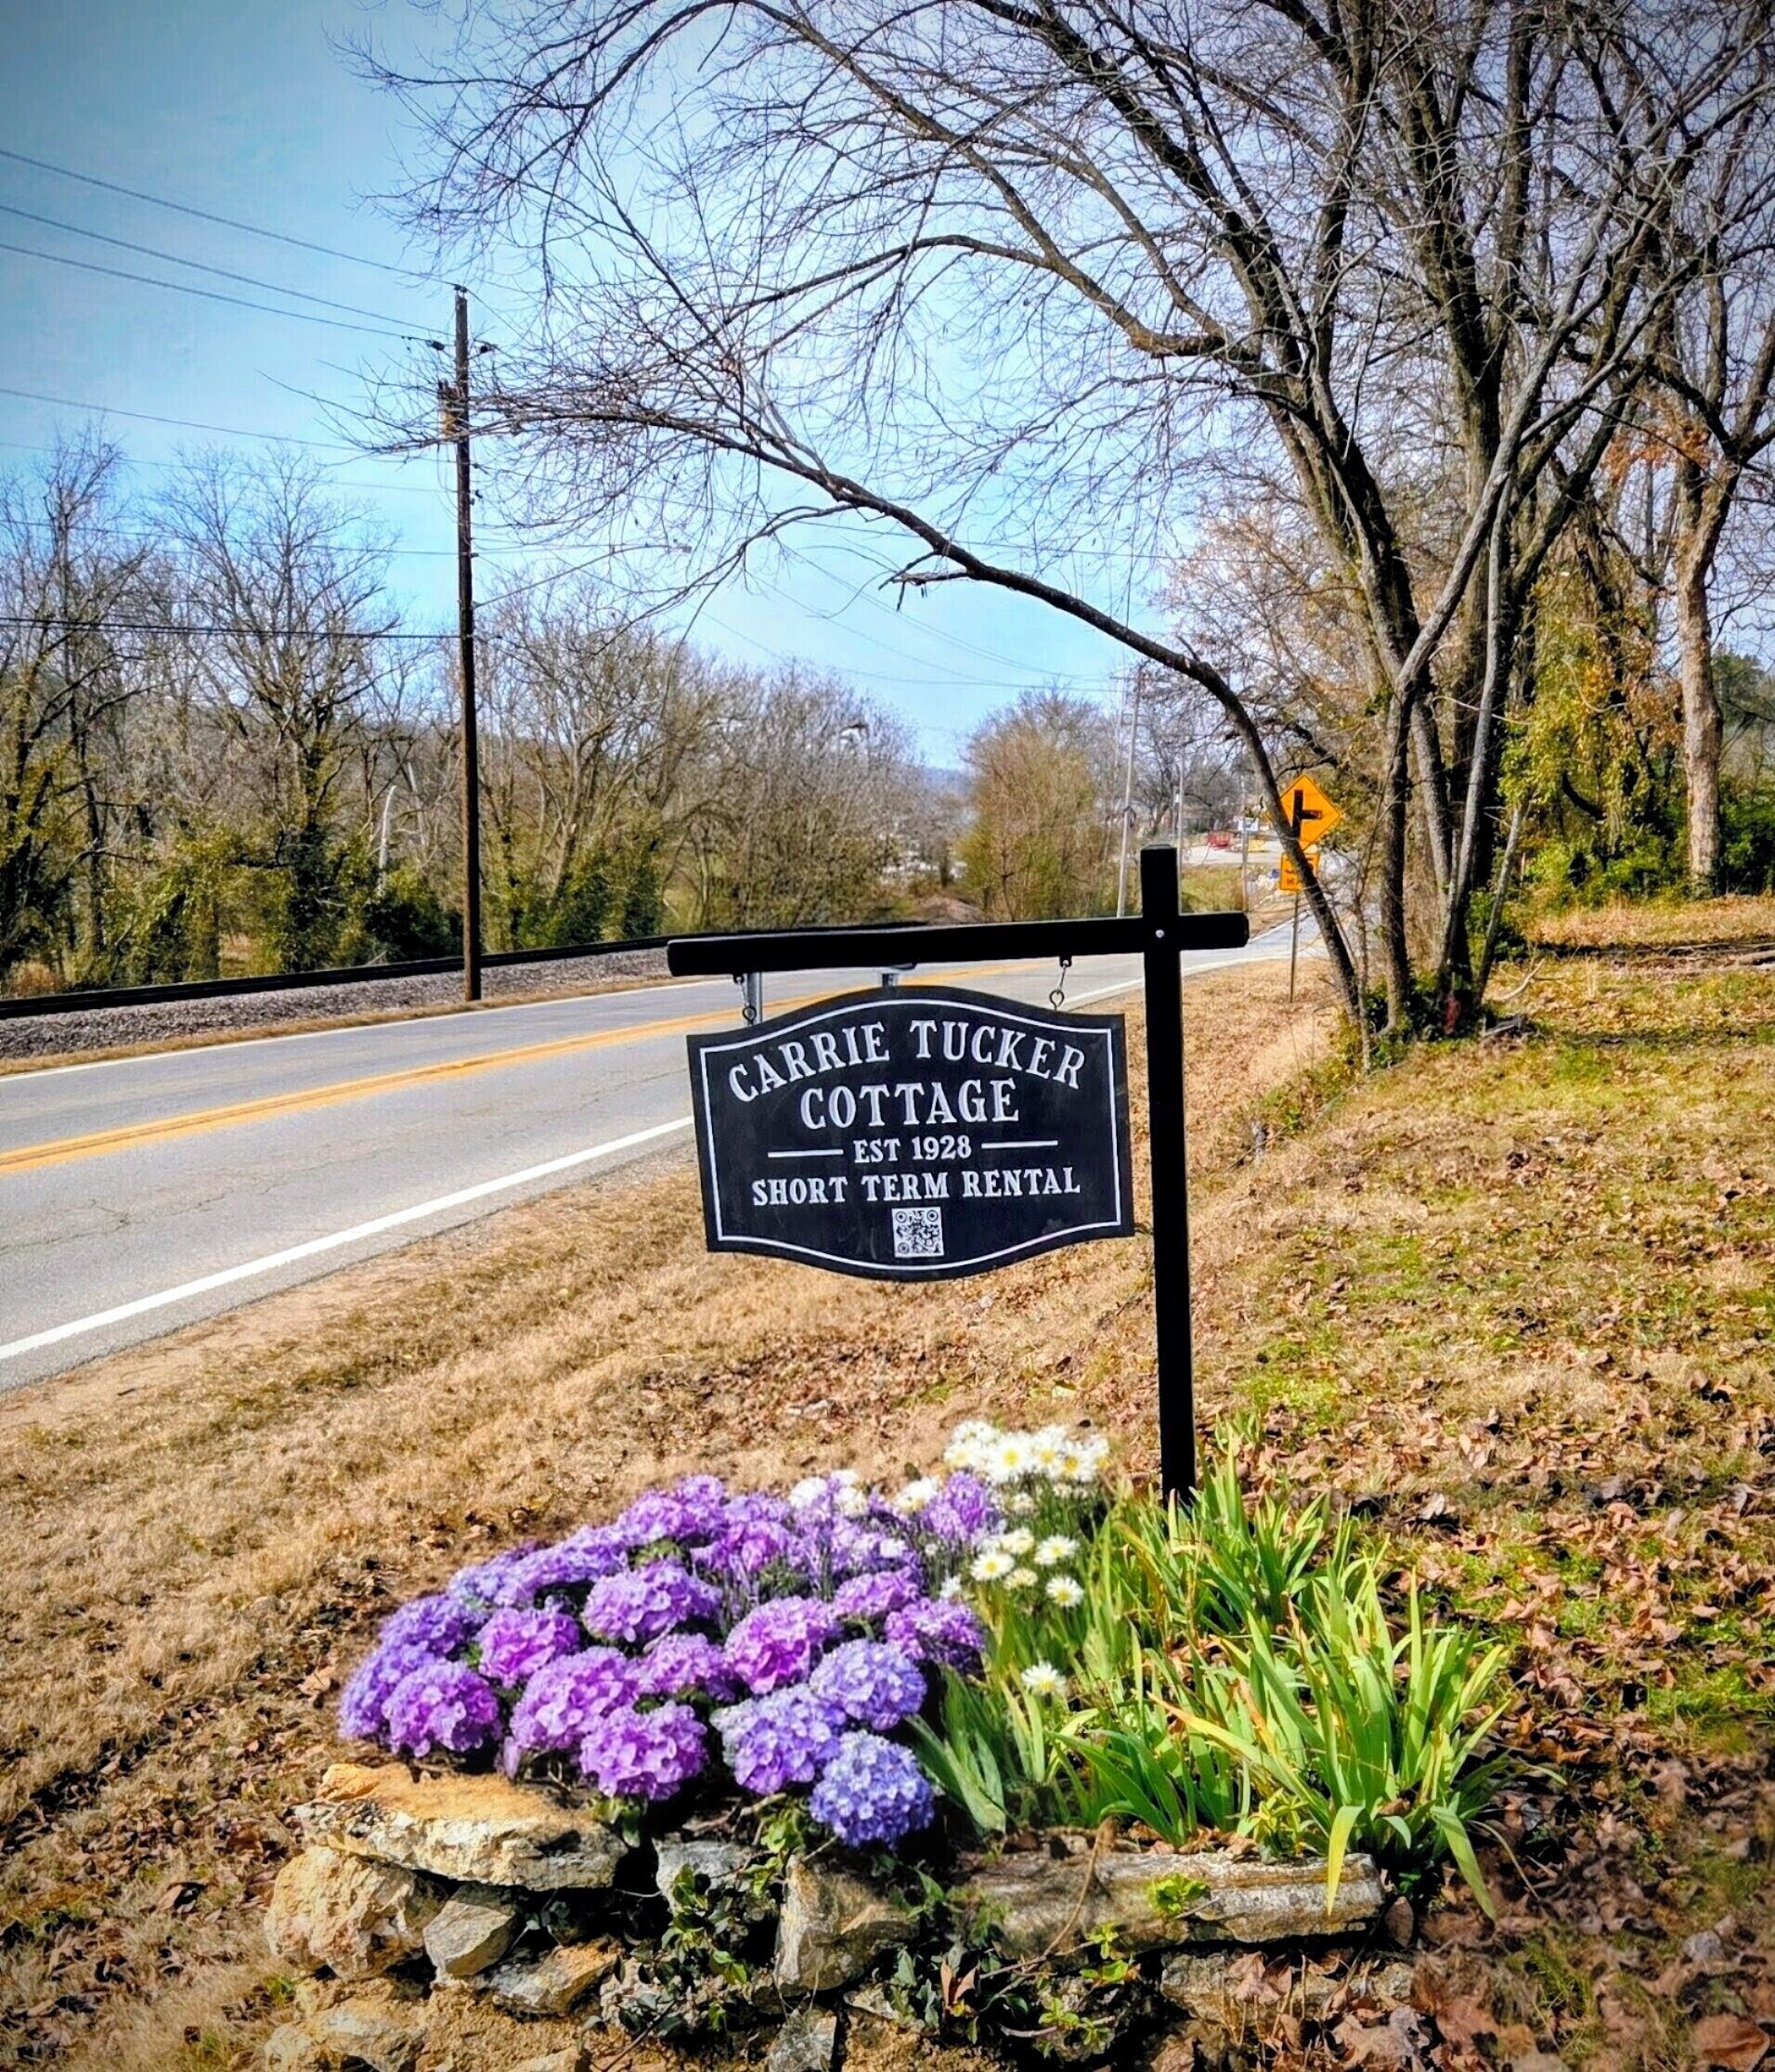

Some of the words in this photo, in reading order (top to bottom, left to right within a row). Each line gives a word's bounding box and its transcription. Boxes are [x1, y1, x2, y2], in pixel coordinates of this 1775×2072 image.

[730, 1022, 889, 1102] CARRIE
[910, 1020, 1084, 1089] TUCKER
[801, 1078, 1018, 1129] COTTAGE
[853, 1138, 900, 1163] EST
[912, 1135, 971, 1160] 1928
[752, 1177, 848, 1206] SHORT
[862, 1172, 949, 1201] TERM
[962, 1167, 1080, 1198] RENTAL
